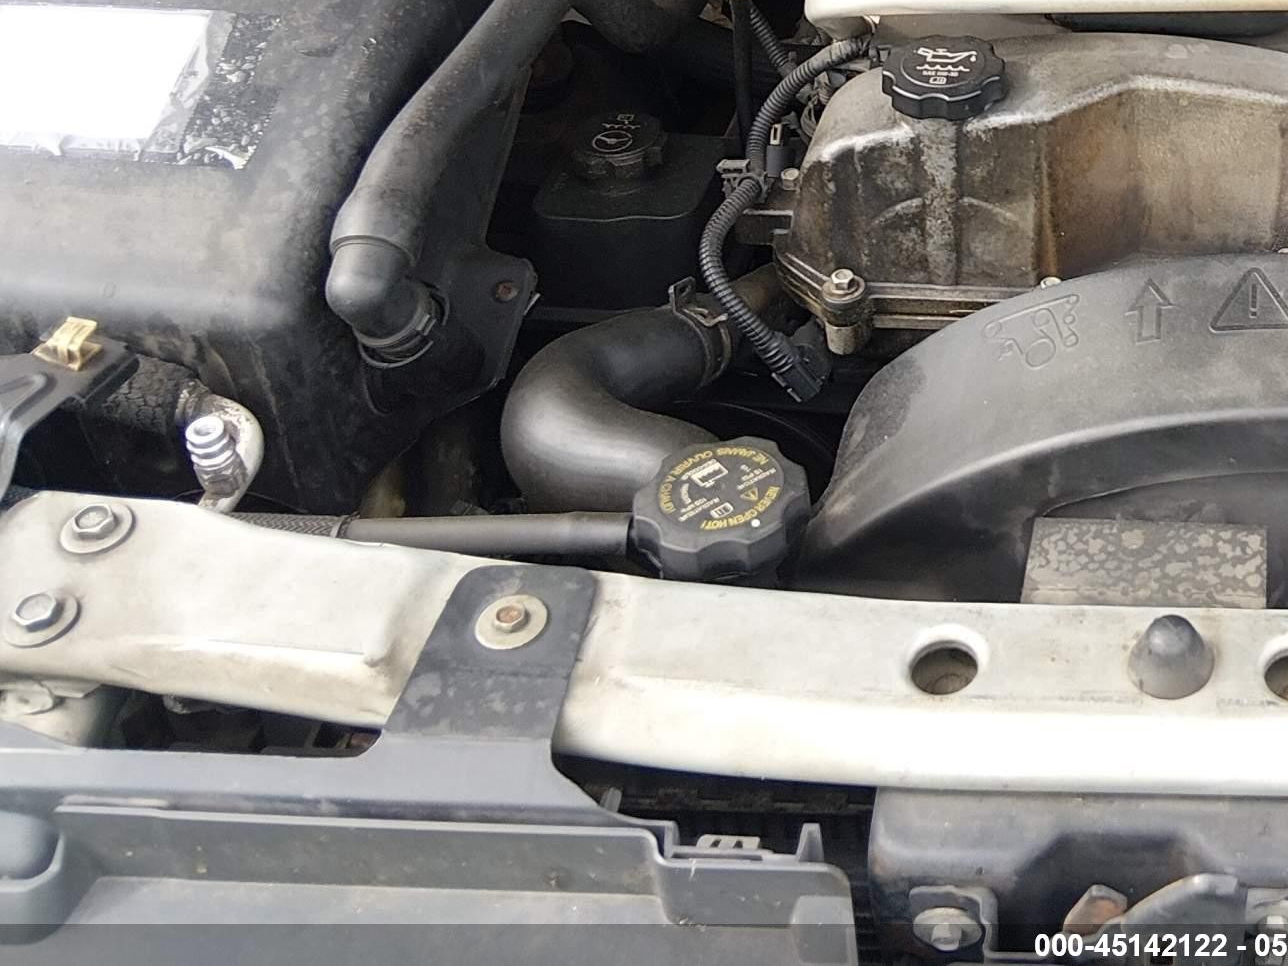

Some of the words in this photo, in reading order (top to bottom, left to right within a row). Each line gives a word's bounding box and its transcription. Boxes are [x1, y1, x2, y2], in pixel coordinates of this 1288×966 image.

[737, 467, 776, 490] RADIATOR
[757, 486, 780, 514] NEVER
[701, 518, 727, 531] HOT!
[728, 510, 758, 525] OPEN
